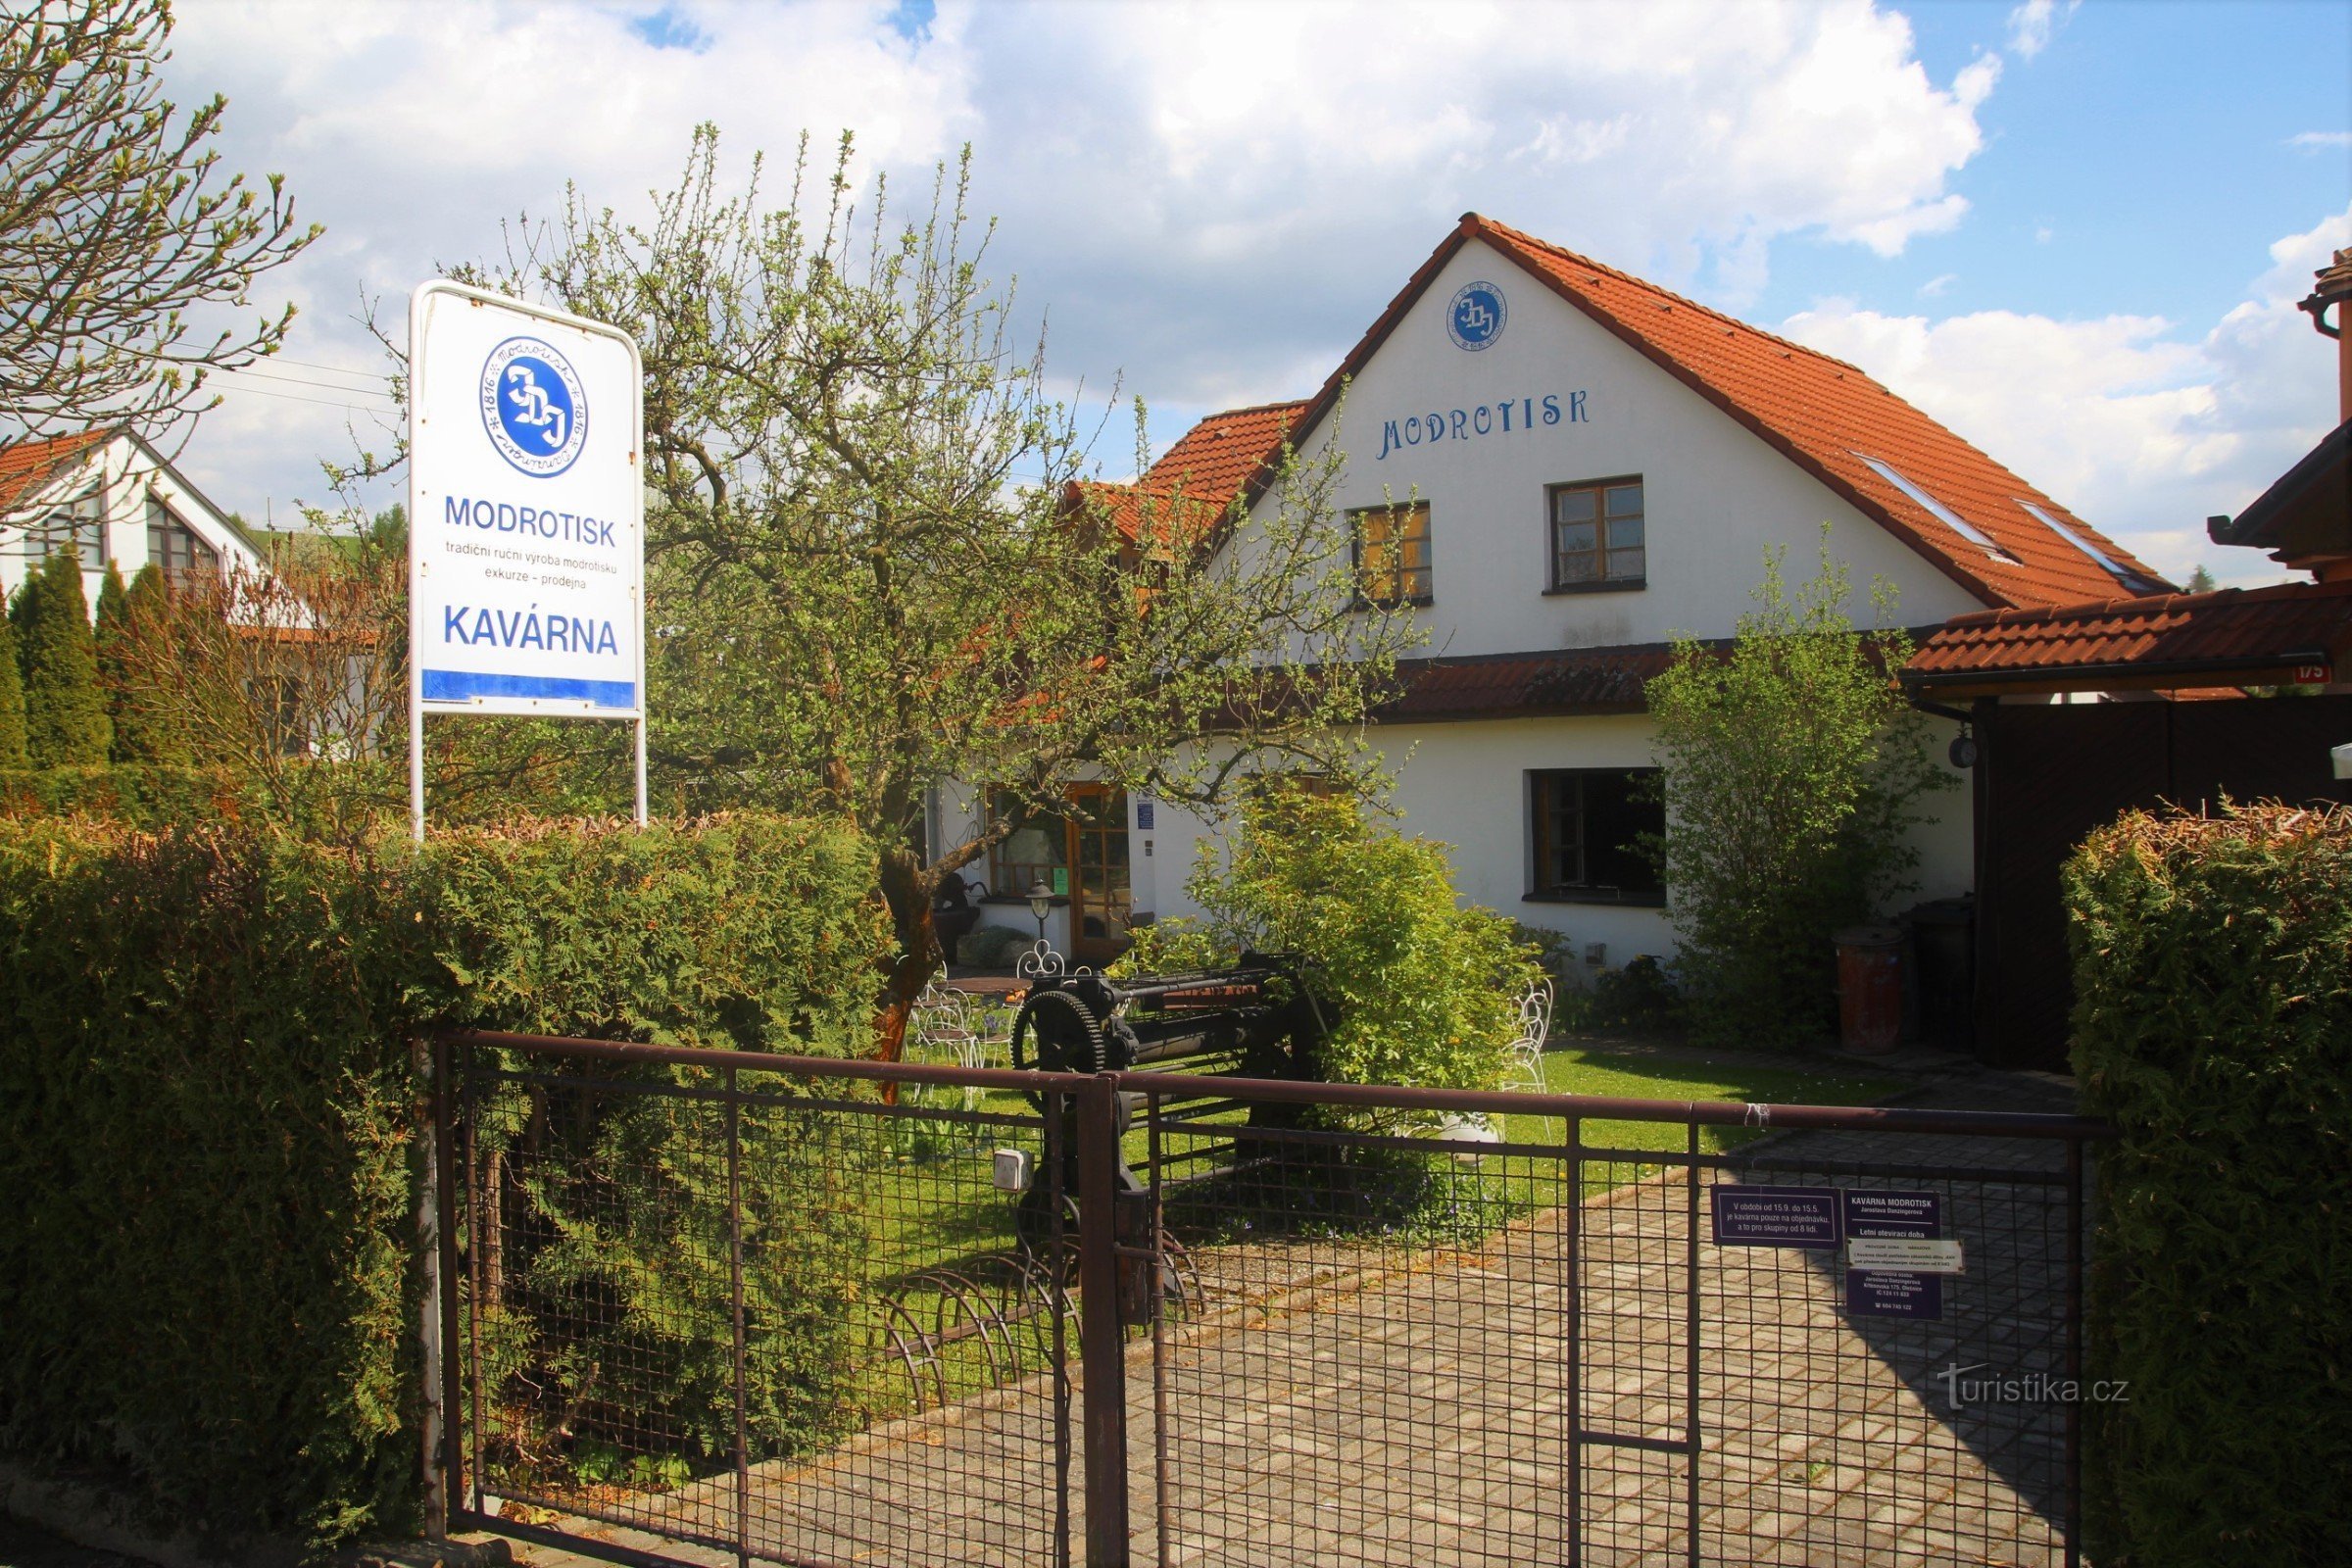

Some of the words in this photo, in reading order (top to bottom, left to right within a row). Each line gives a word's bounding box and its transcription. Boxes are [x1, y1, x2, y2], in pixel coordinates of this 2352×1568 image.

[483, 377, 496, 414] 1816
[574, 403, 585, 436] 1816
[1375, 390, 1590, 461] MODROTISK
[445, 496, 615, 548] MODROTISK
[446, 541, 491, 557] tradiční
[494, 548, 522, 561] ruční
[525, 551, 561, 565] výroba
[563, 557, 617, 574] modrotisku
[484, 566, 529, 582] exkurze
[541, 573, 586, 590] prodejna
[445, 603, 618, 656] KAVÁRNA
[1851, 1196, 1886, 1206] KAVÁRNA
[1887, 1198, 1932, 1208] MODROTISK
[1908, 1230, 1925, 1239] doba
